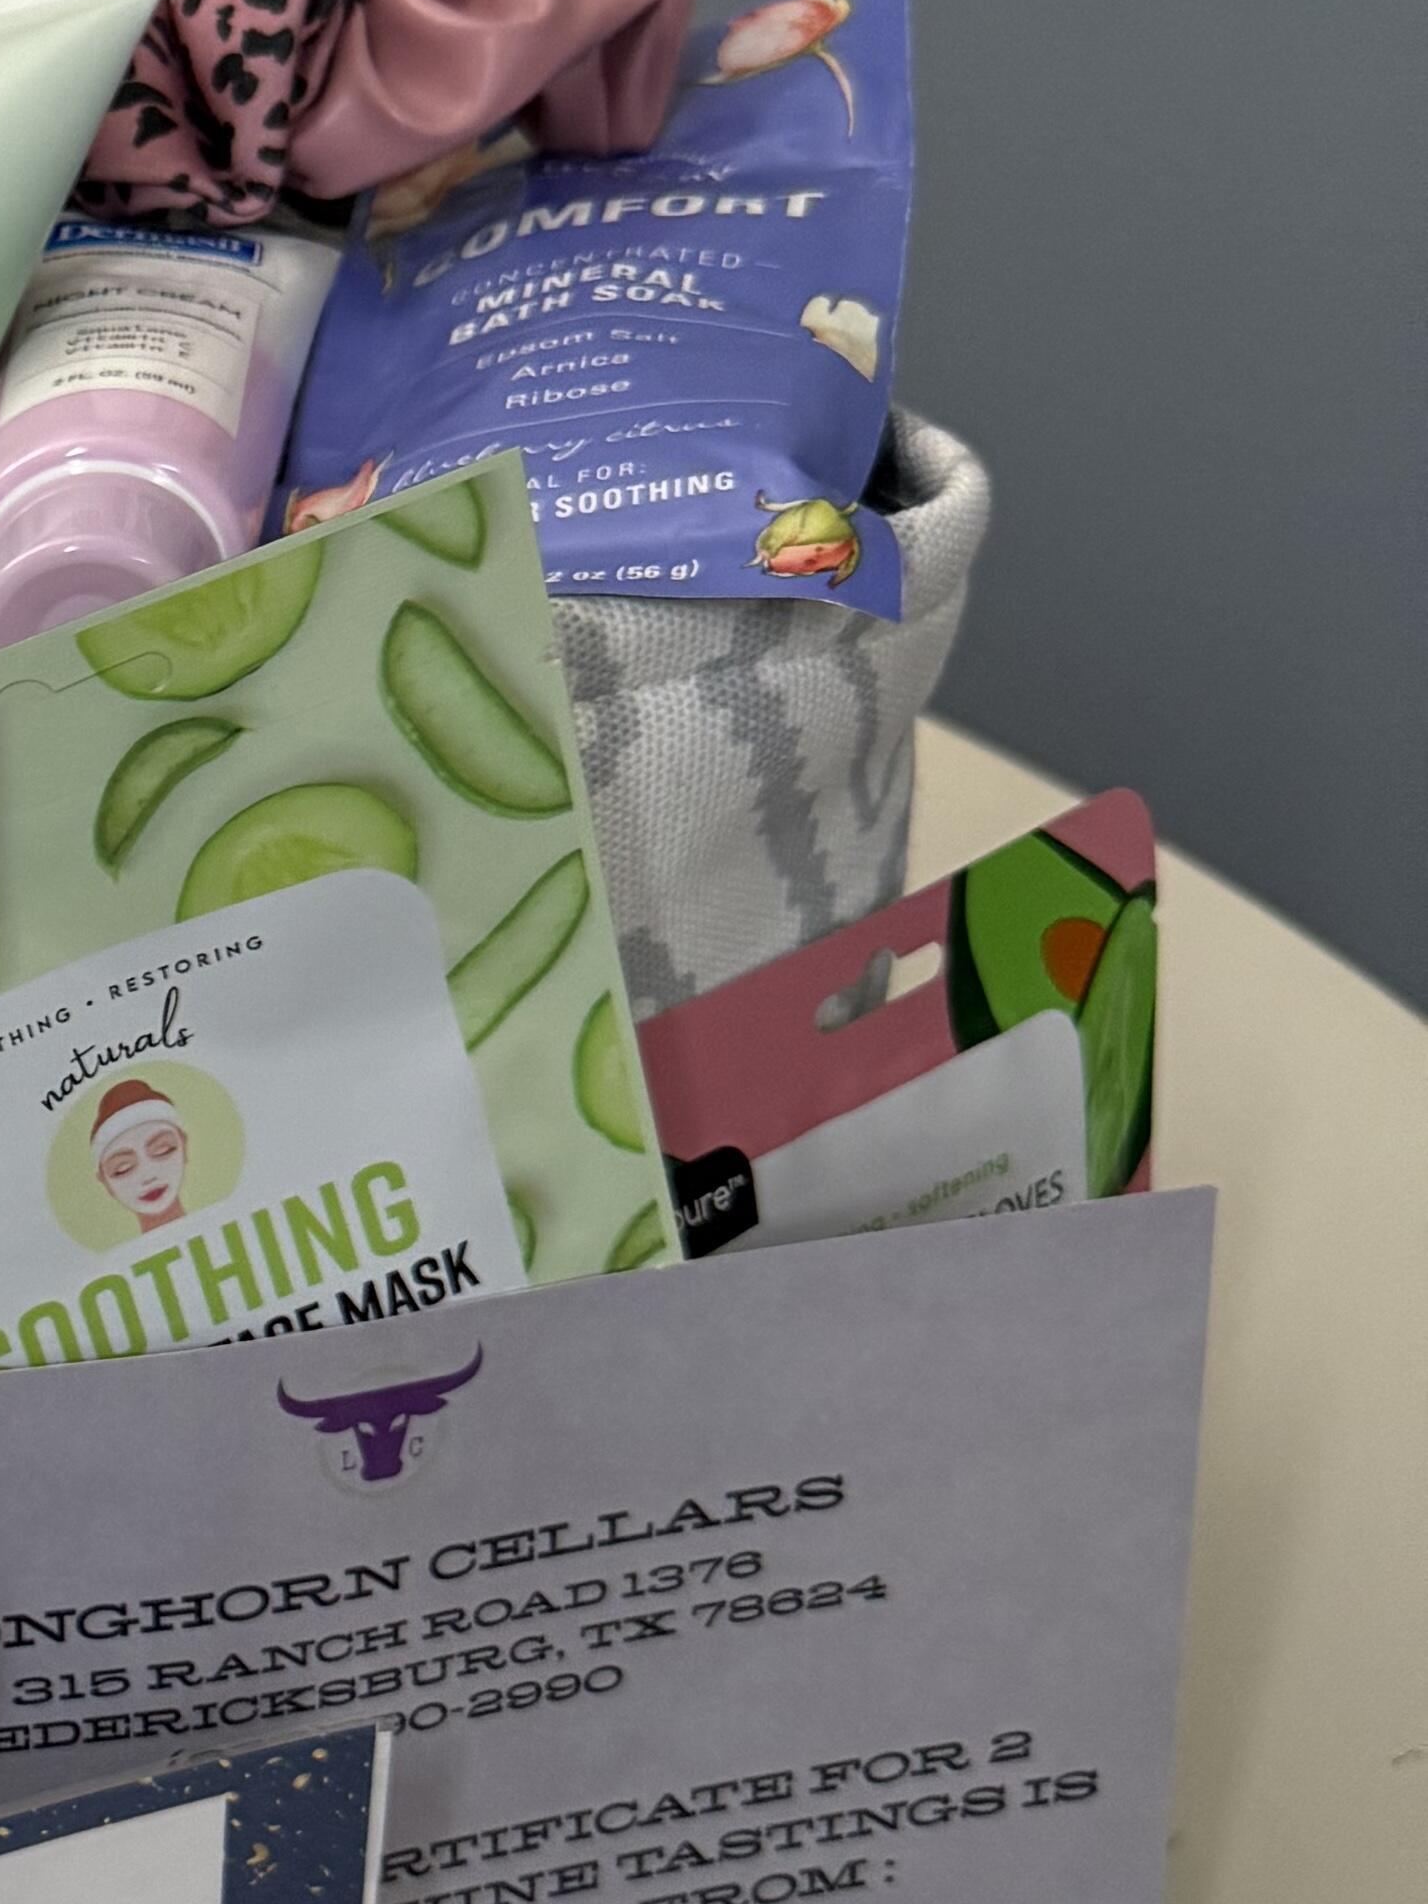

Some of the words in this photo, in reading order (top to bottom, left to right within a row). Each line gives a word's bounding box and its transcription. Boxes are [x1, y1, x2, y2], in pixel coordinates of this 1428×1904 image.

[412, 190, 826, 288] COMFORT
[448, 291, 571, 346] BATH
[591, 284, 728, 314] SOAK
[476, 262, 703, 314] MINERAL
[475, 329, 597, 371] Epsom
[510, 352, 632, 382] Arnica
[504, 379, 633, 410] Ribose
[554, 470, 737, 520] SOOTHING
[577, 460, 647, 484] FOR:
[571, 569, 607, 582] oz
[615, 564, 662, 583] (56
[669, 559, 701, 581] g)
[108, 934, 266, 1002] RESTORING
[40, 986, 195, 1112] naturals
[334, 1239, 482, 1328] MASK
[428, 1472, 847, 1581] CELLARS
[11, 1668, 131, 1708] 315
[147, 1622, 407, 1692] RANCH
[421, 1579, 606, 1640] ROAD
[622, 1550, 765, 1601] 1376
[580, 1608, 677, 1652] TX
[690, 1573, 888, 1631] 78624
[380, 1769, 795, 1884] RTIFICATE
[810, 1740, 969, 1795] FOR
[987, 1730, 1034, 1767] 2
[615, 1783, 1009, 1882] TASTINGS
[1019, 1768, 1100, 1810] IS
